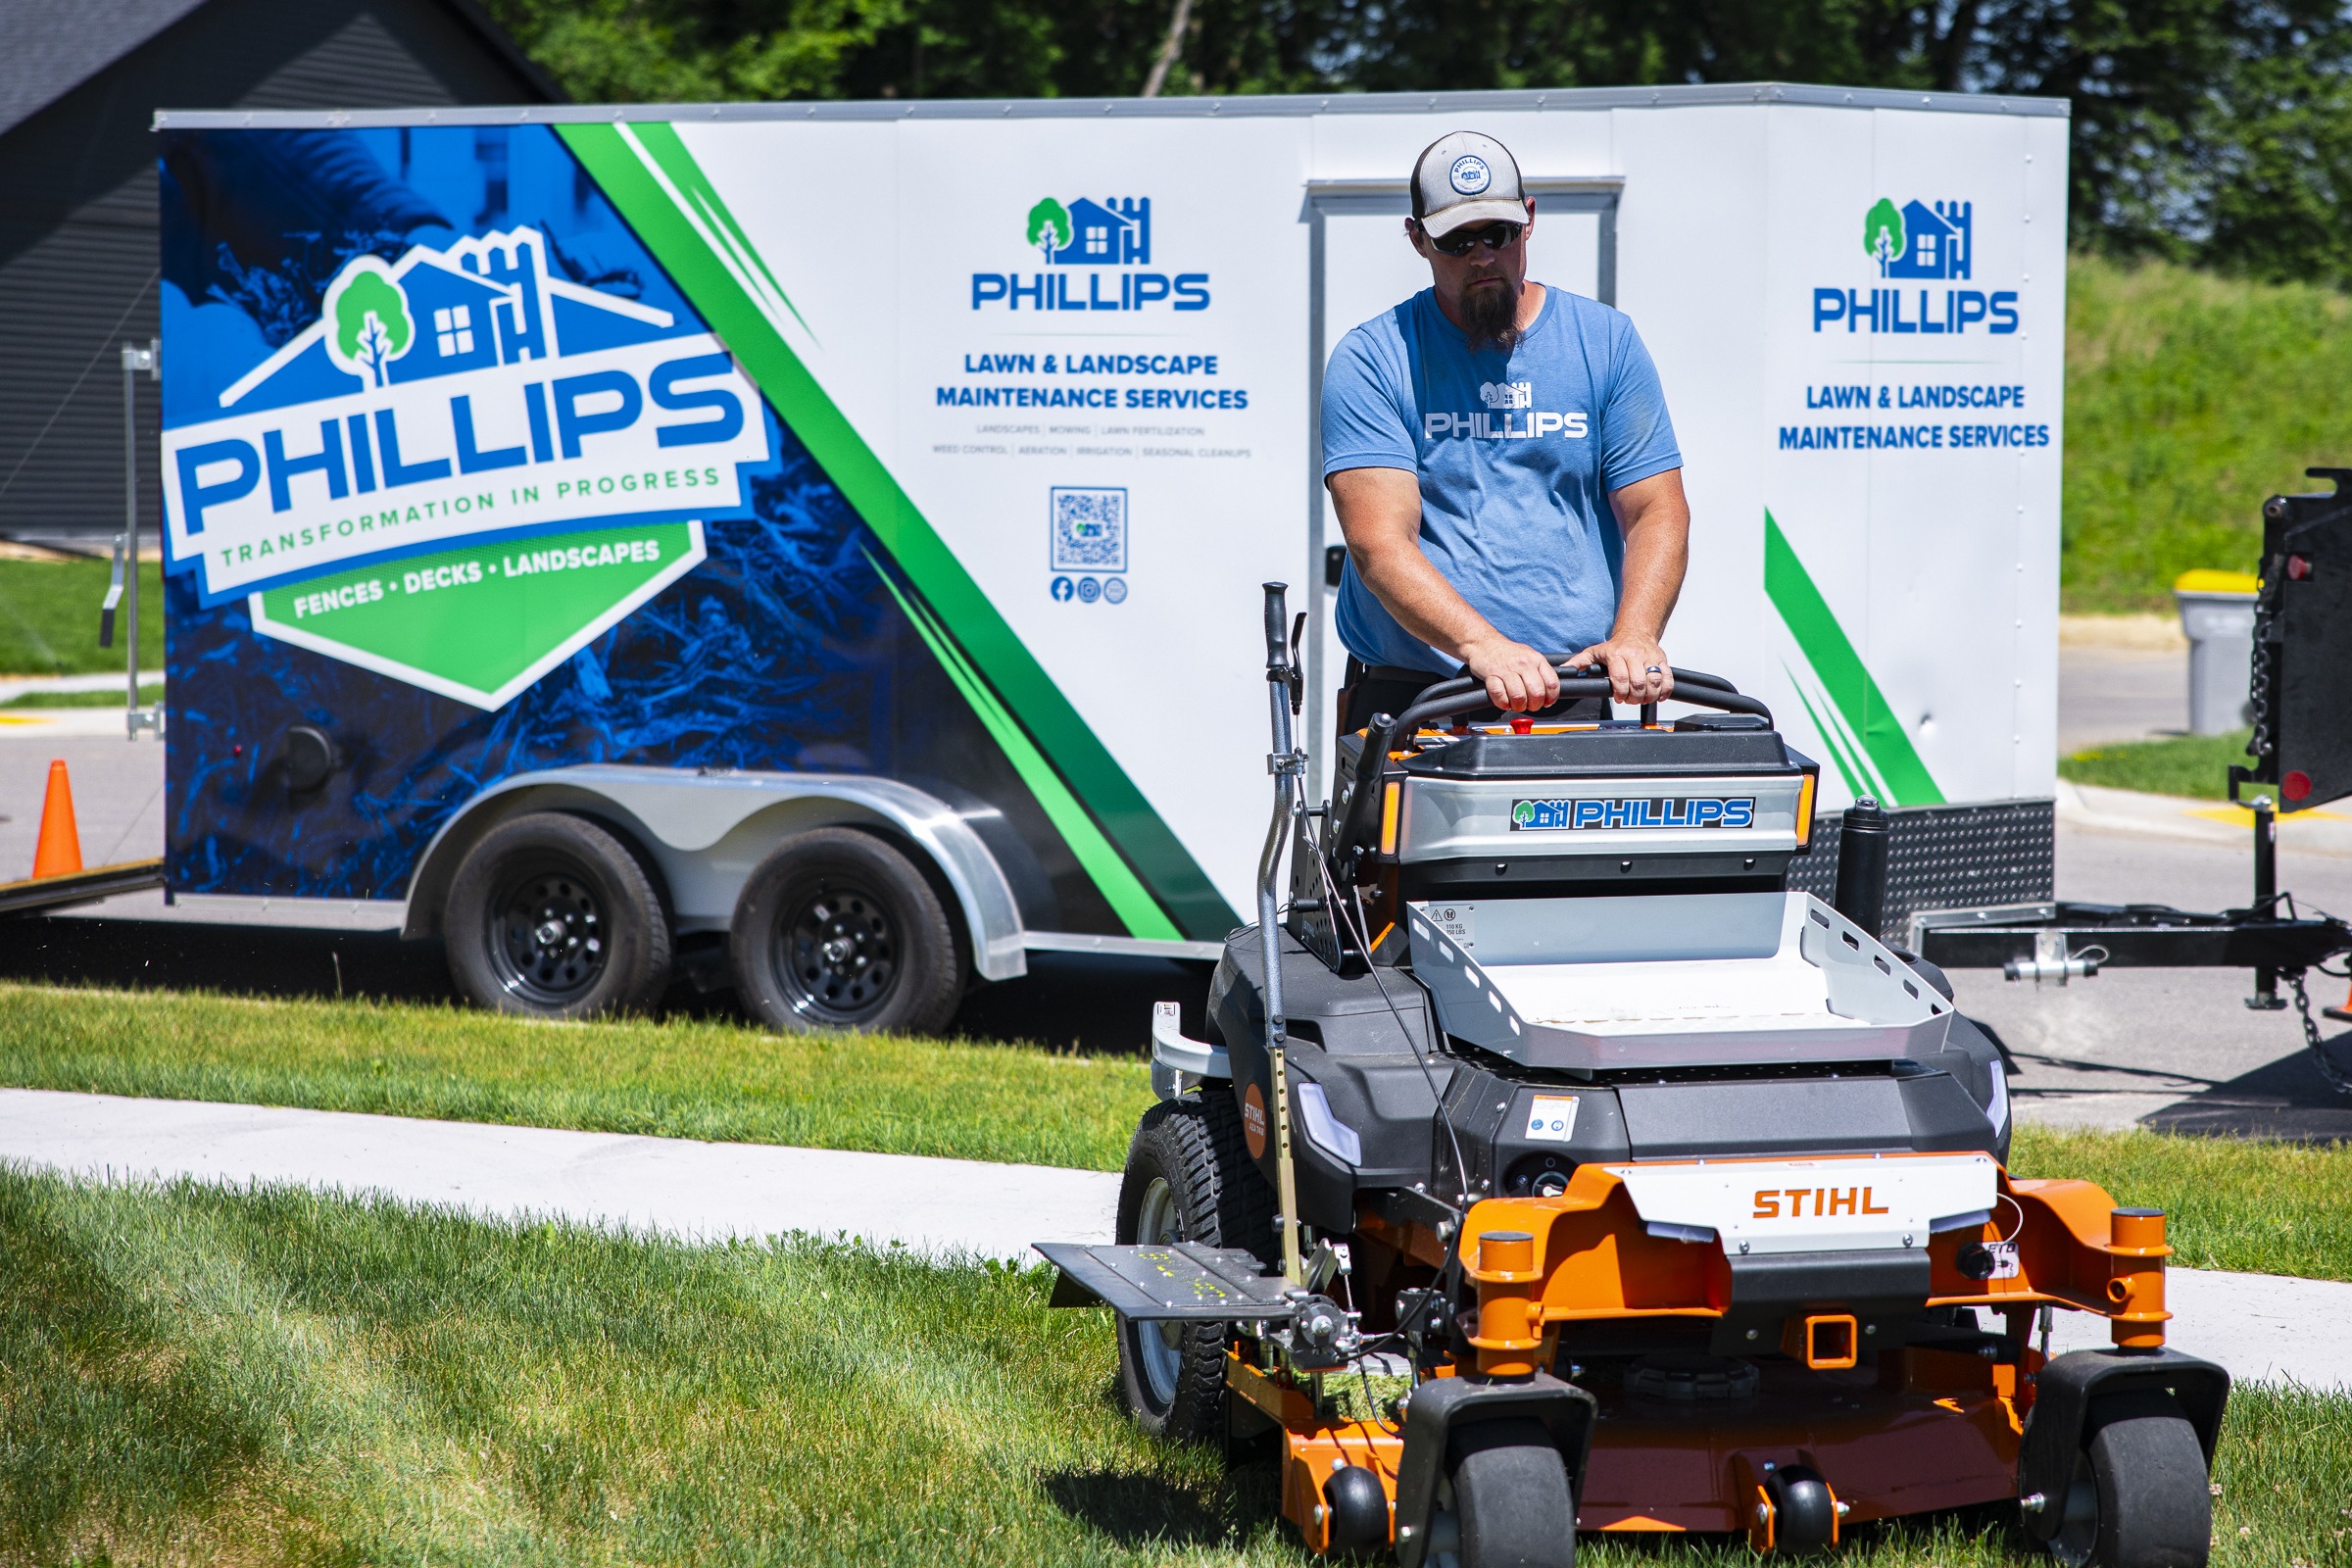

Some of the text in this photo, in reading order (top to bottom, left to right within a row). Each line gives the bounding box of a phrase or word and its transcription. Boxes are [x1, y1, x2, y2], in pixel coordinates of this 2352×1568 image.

[1453, 158, 1486, 173] PHILLIPS
[972, 273, 1210, 311] PHILLIPS
[1813, 288, 2020, 334] PHILLIPS
[964, 354, 1219, 375] LAWN & LANDSCAPE
[936, 386, 1250, 410] MAINTENANCE SERVICES
[1806, 385, 2026, 410] LAWN & LANDSCAPE
[976, 424, 1205, 437] LANDSCAPES MOWING LAWN FERTILIZATION
[1424, 412, 1589, 440] PHILLIPS
[1779, 424, 2050, 451] MAINTENANCE SERVICES
[174, 351, 745, 537] PHILLIPS
[932, 445, 1252, 460] WEED CONTROL AERATION IRRIGATION SEASONAL CLEANUPS
[220, 467, 720, 567] TRANSFORMATION IN PROGRESS
[294, 539, 662, 619] FENCES DECKS LANDSCAPES
[1573, 799, 1754, 829] PHILLIPS
[1245, 1102, 1265, 1125] STIHL
[1752, 1186, 1889, 1219] STIHL
